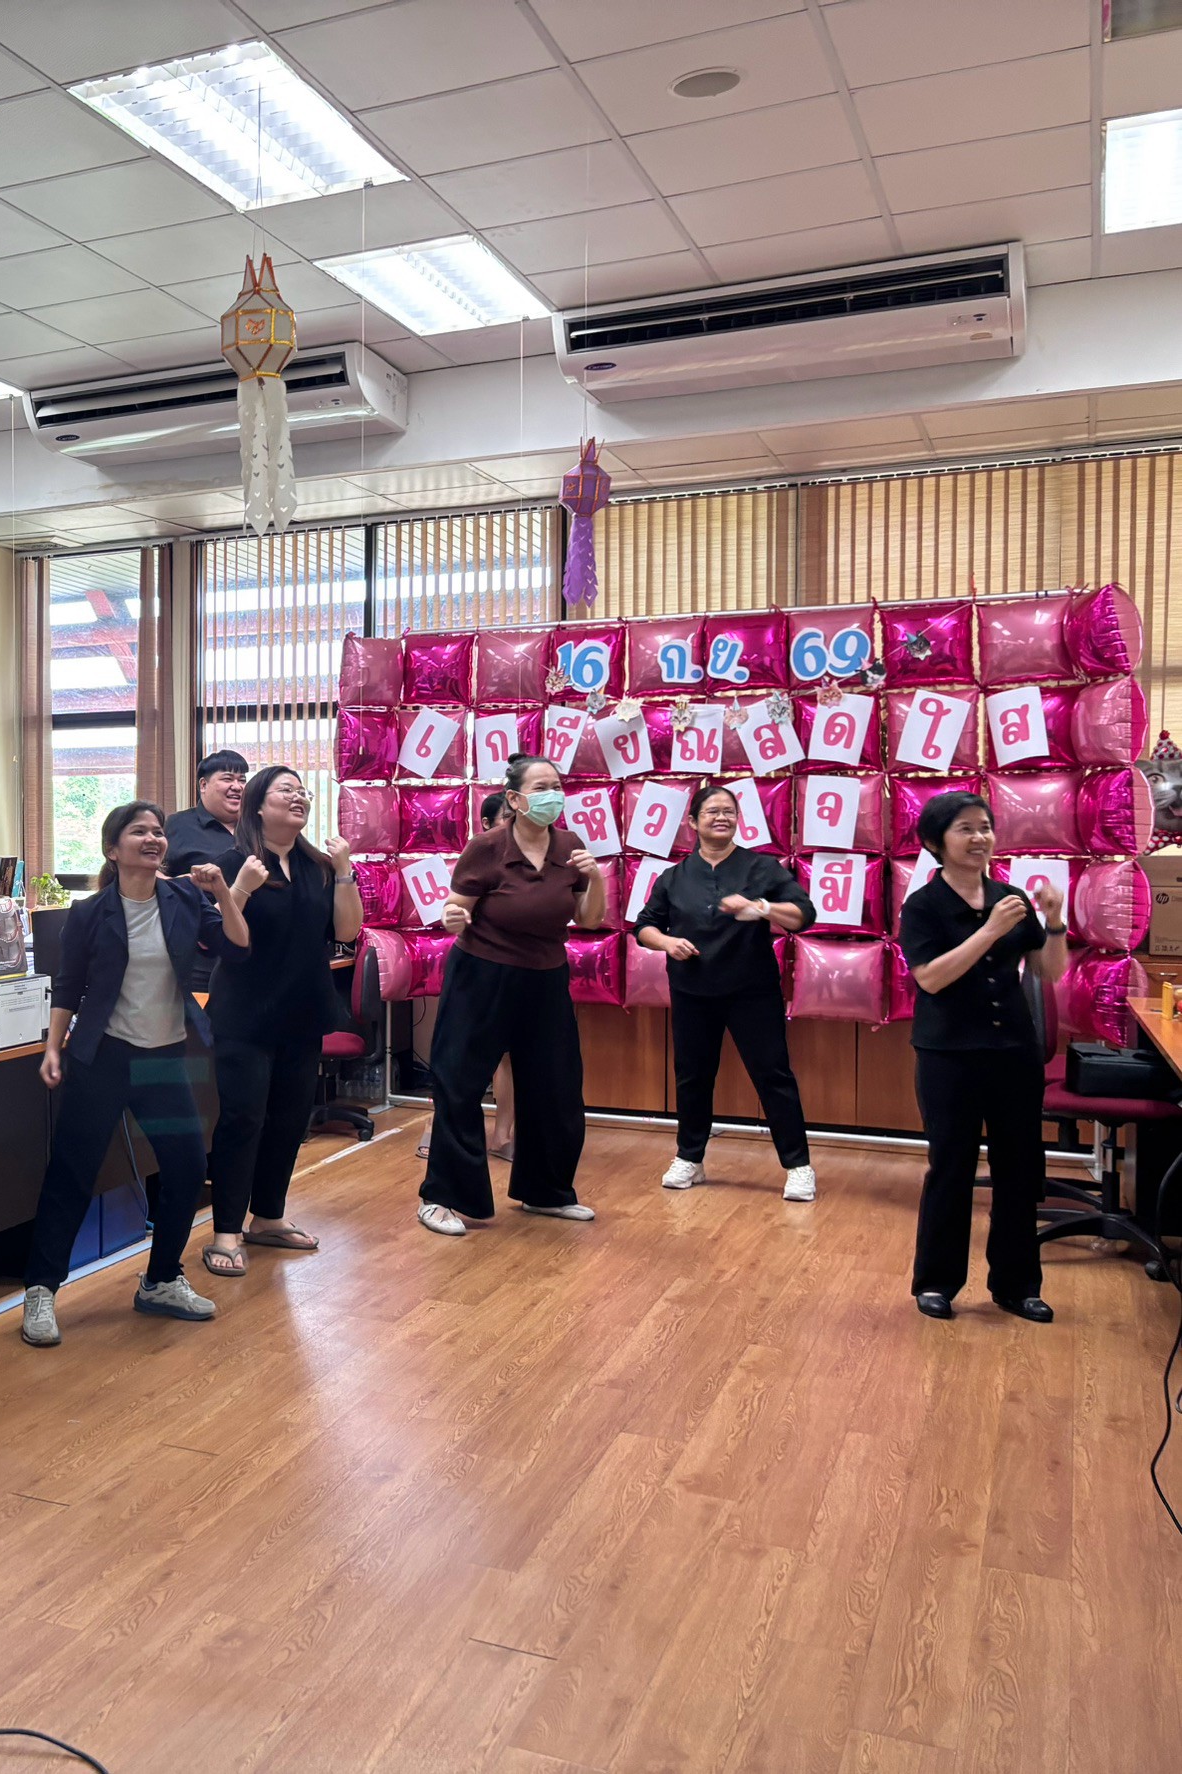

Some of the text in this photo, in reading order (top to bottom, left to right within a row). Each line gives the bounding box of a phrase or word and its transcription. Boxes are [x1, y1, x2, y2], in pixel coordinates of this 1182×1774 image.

[557, 629, 869, 689] 16 ก.ย. 69
